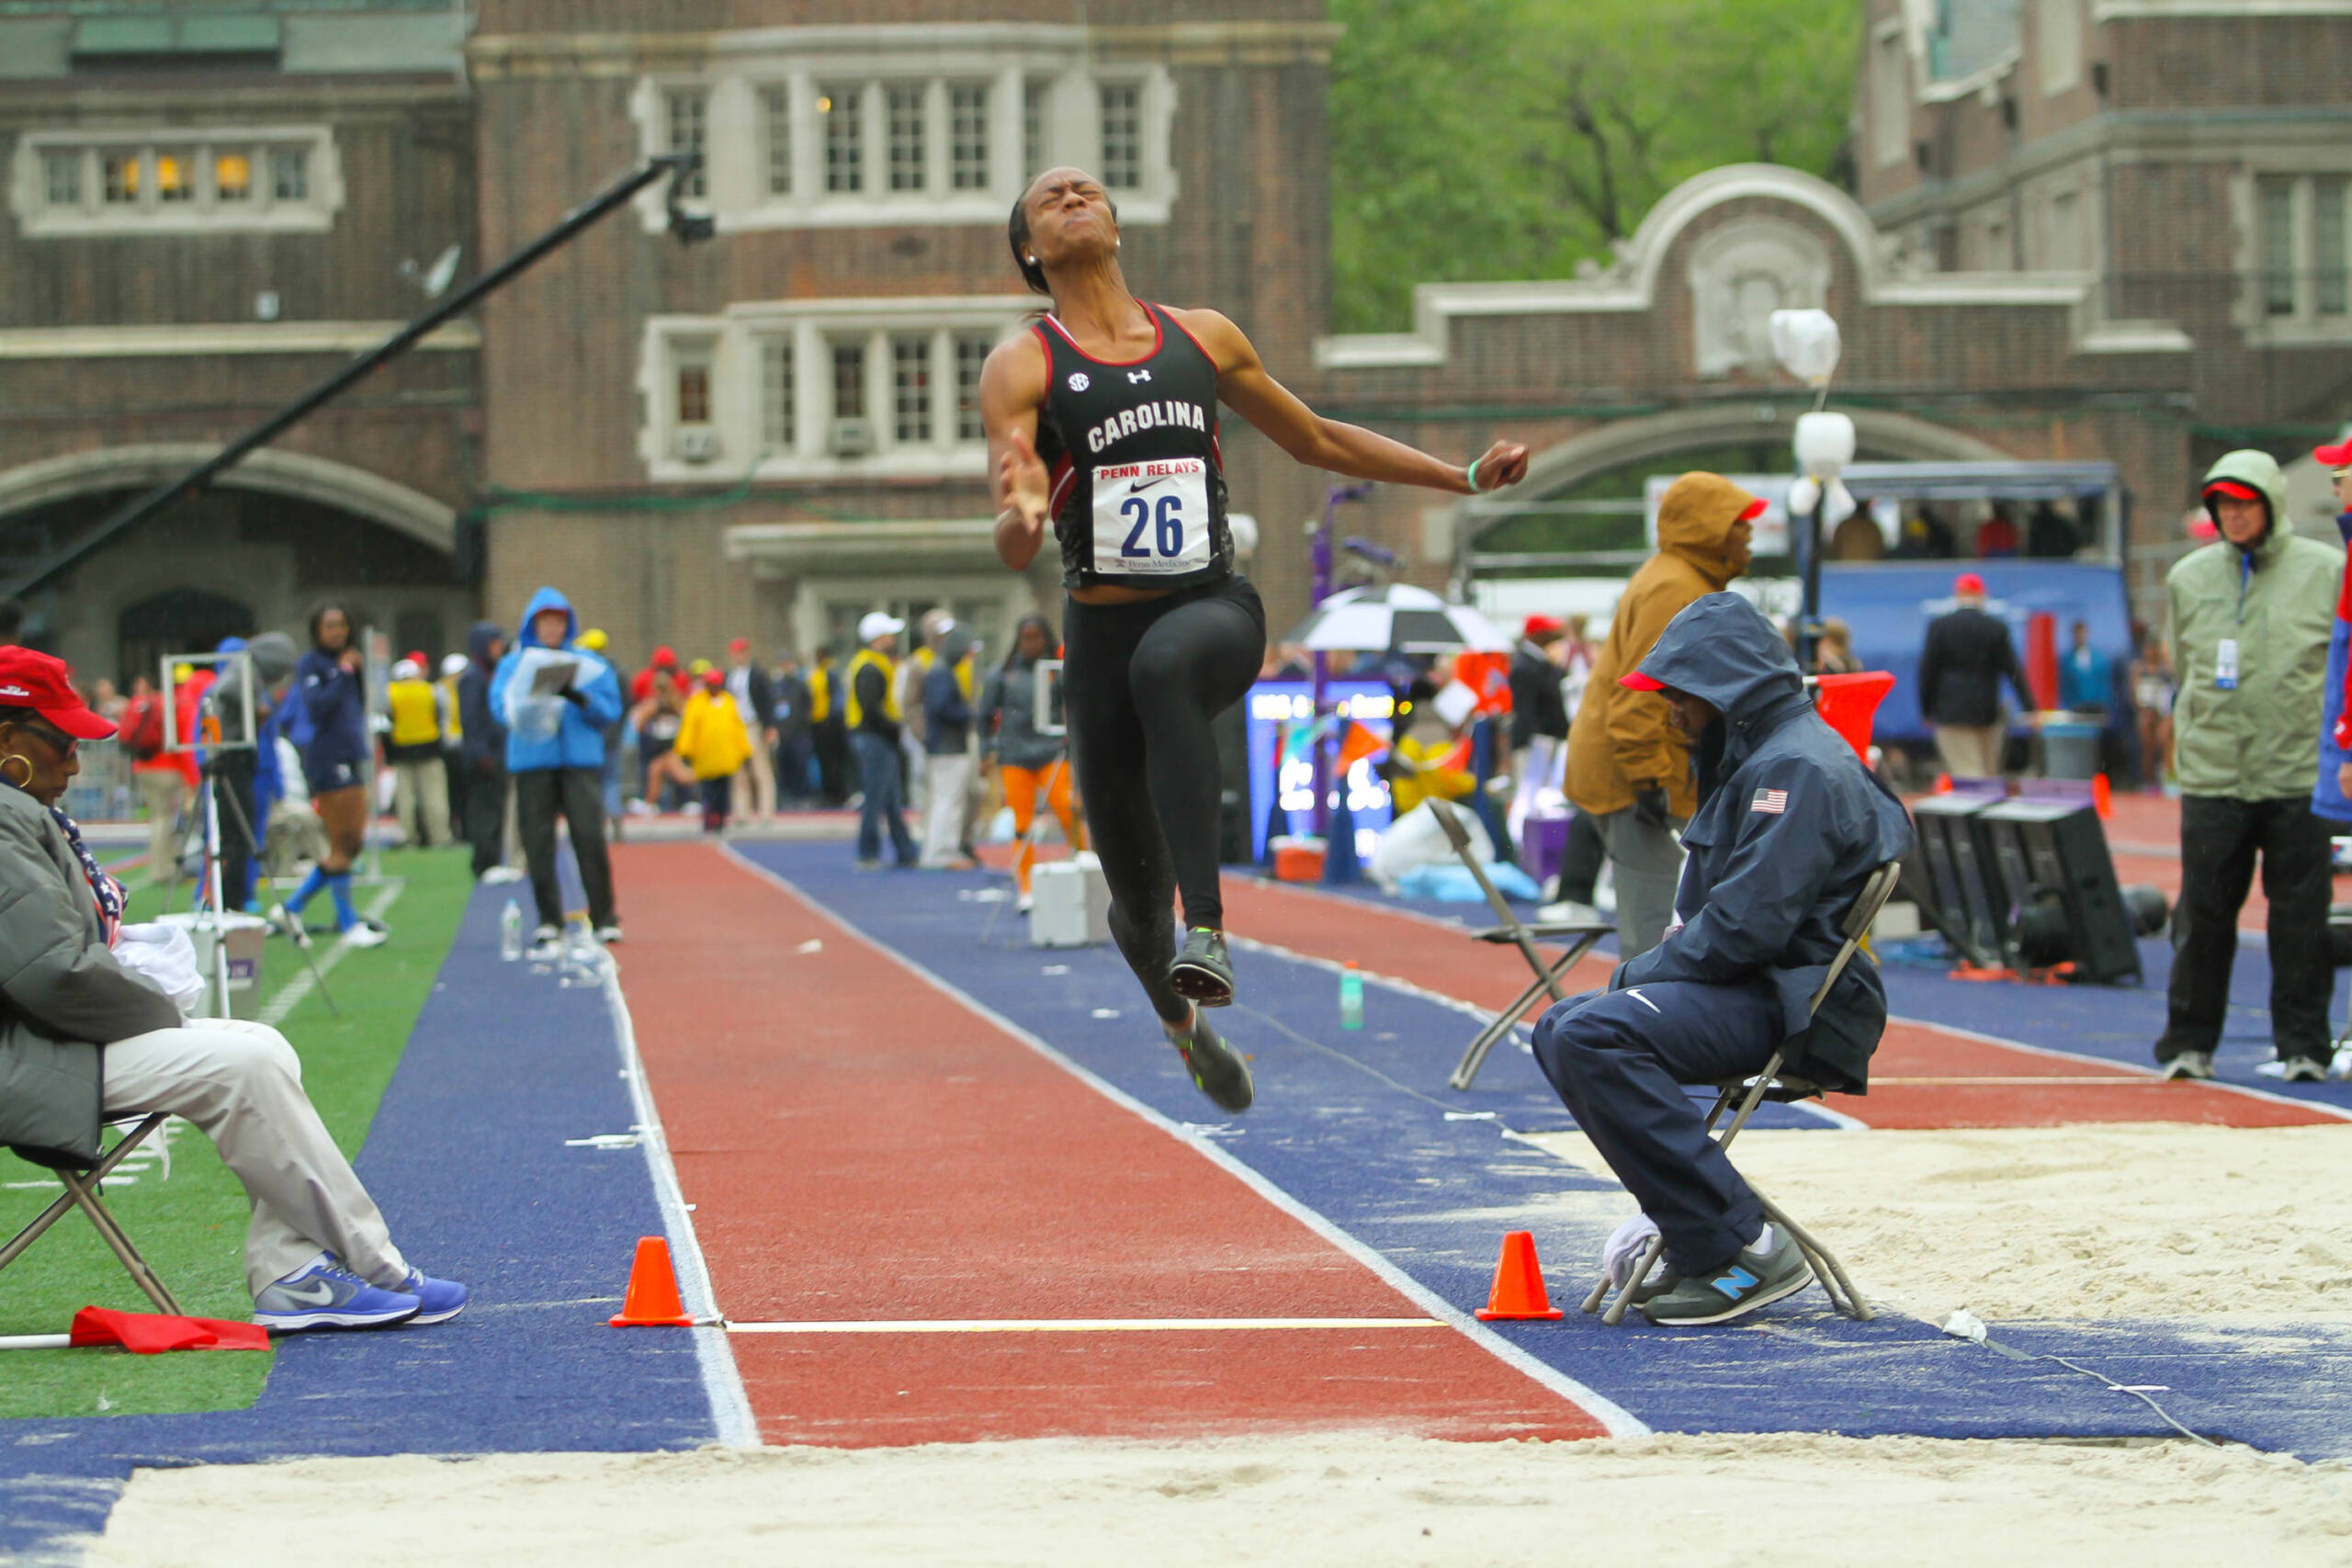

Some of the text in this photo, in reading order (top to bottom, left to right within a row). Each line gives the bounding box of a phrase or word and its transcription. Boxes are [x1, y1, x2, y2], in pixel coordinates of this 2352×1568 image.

[1088, 400, 1205, 454] CAROLINA
[1100, 462, 1200, 479] PENN RELAYS
[1120, 495, 1183, 558] 26
[1711, 1265, 1759, 1301] N
